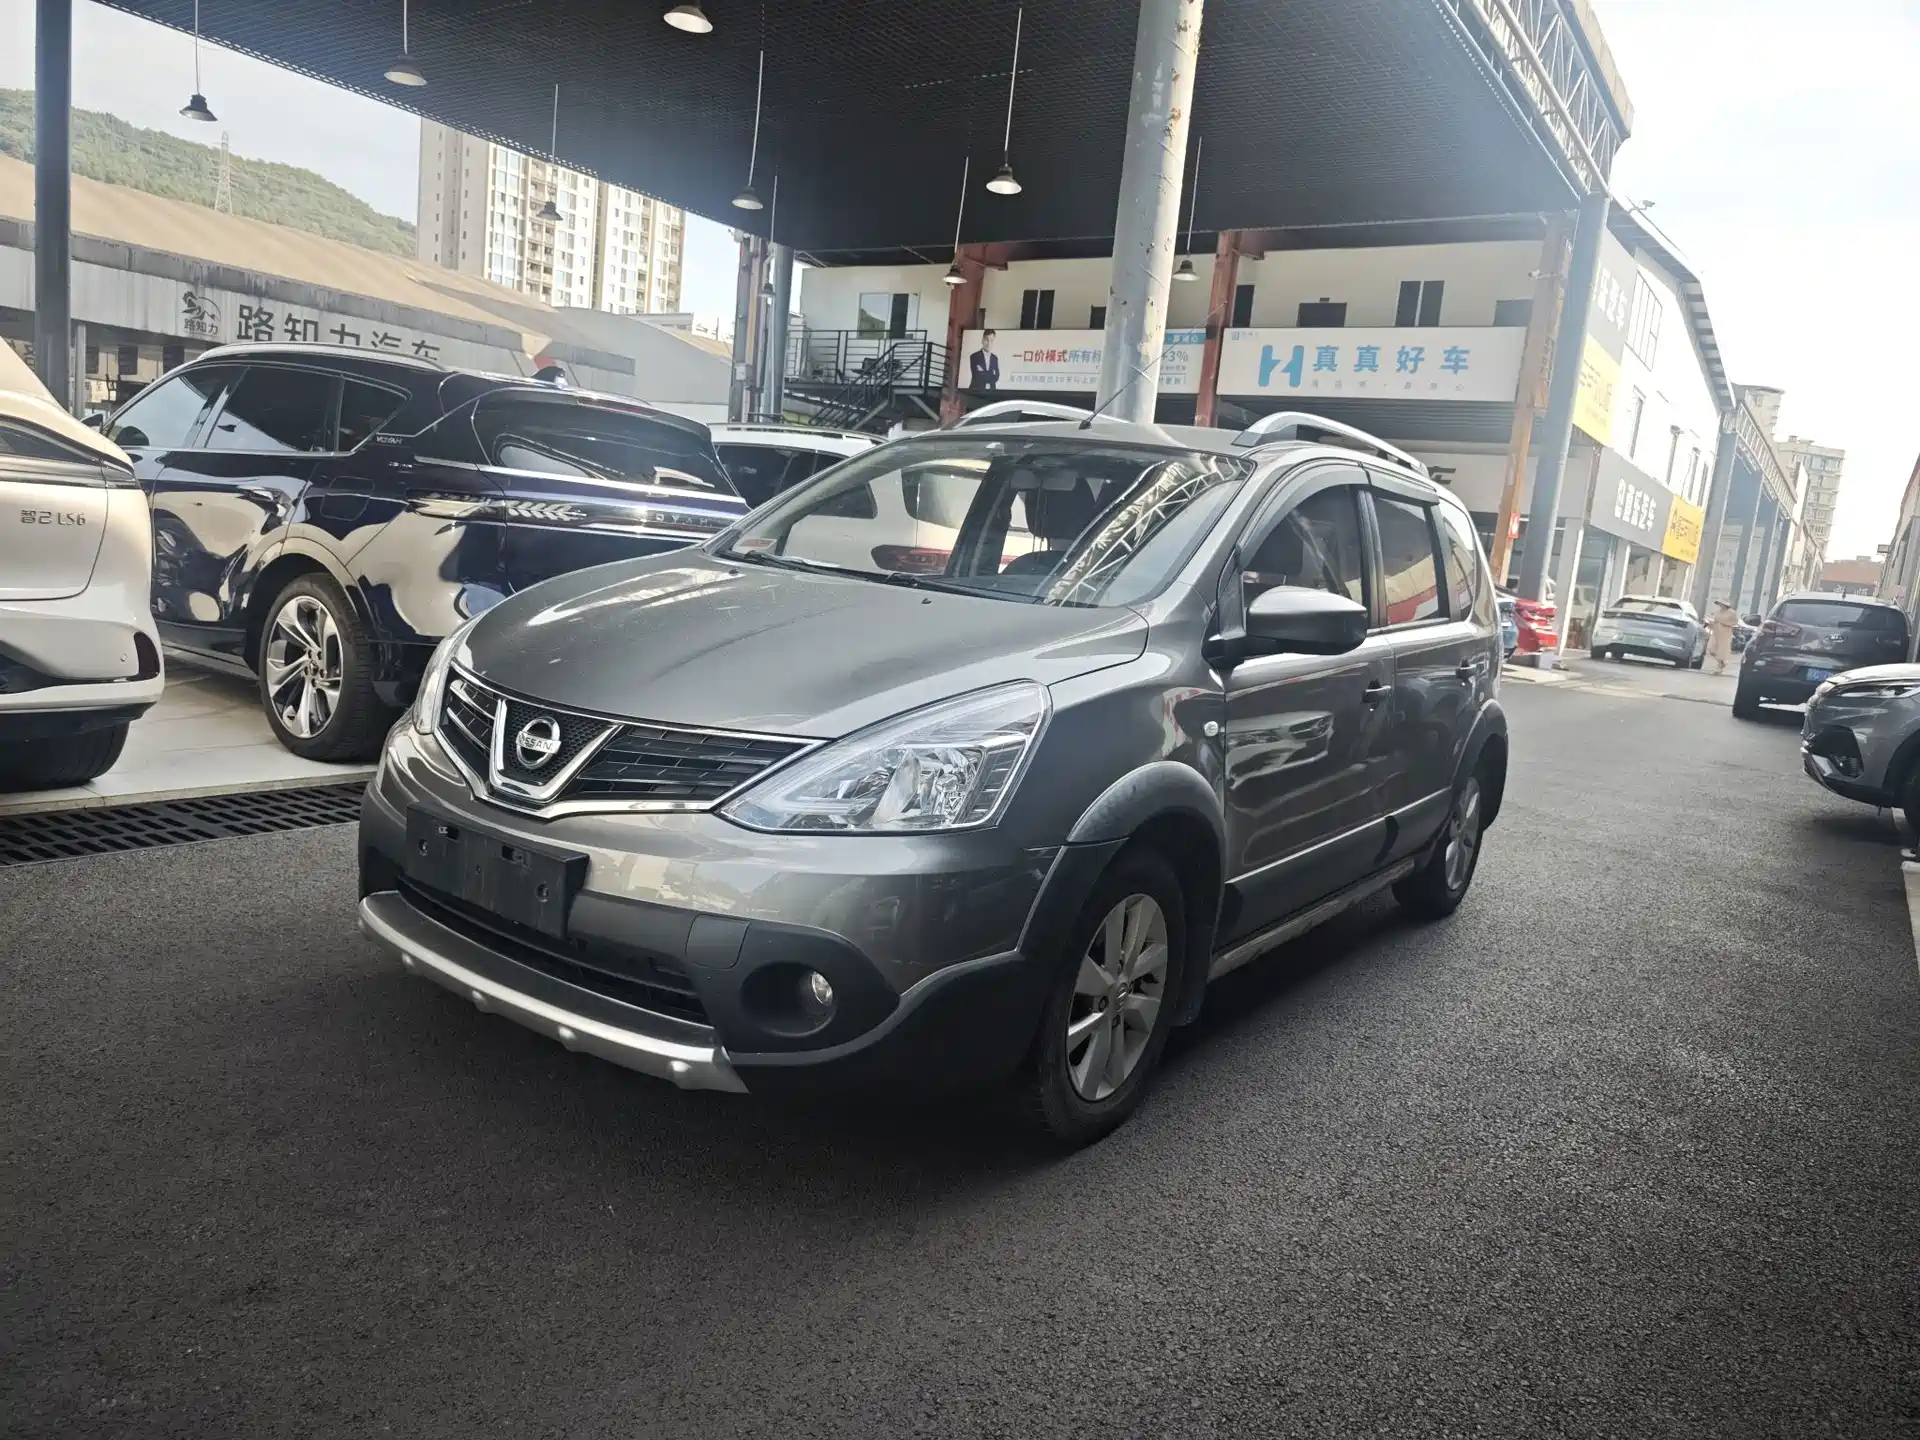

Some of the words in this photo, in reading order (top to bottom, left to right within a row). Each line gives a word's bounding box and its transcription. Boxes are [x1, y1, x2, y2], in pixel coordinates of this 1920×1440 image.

[1312, 345, 1471, 375] 真真好车
[56, 511, 87, 526] LS6
[518, 732, 552, 750] NISSAN
